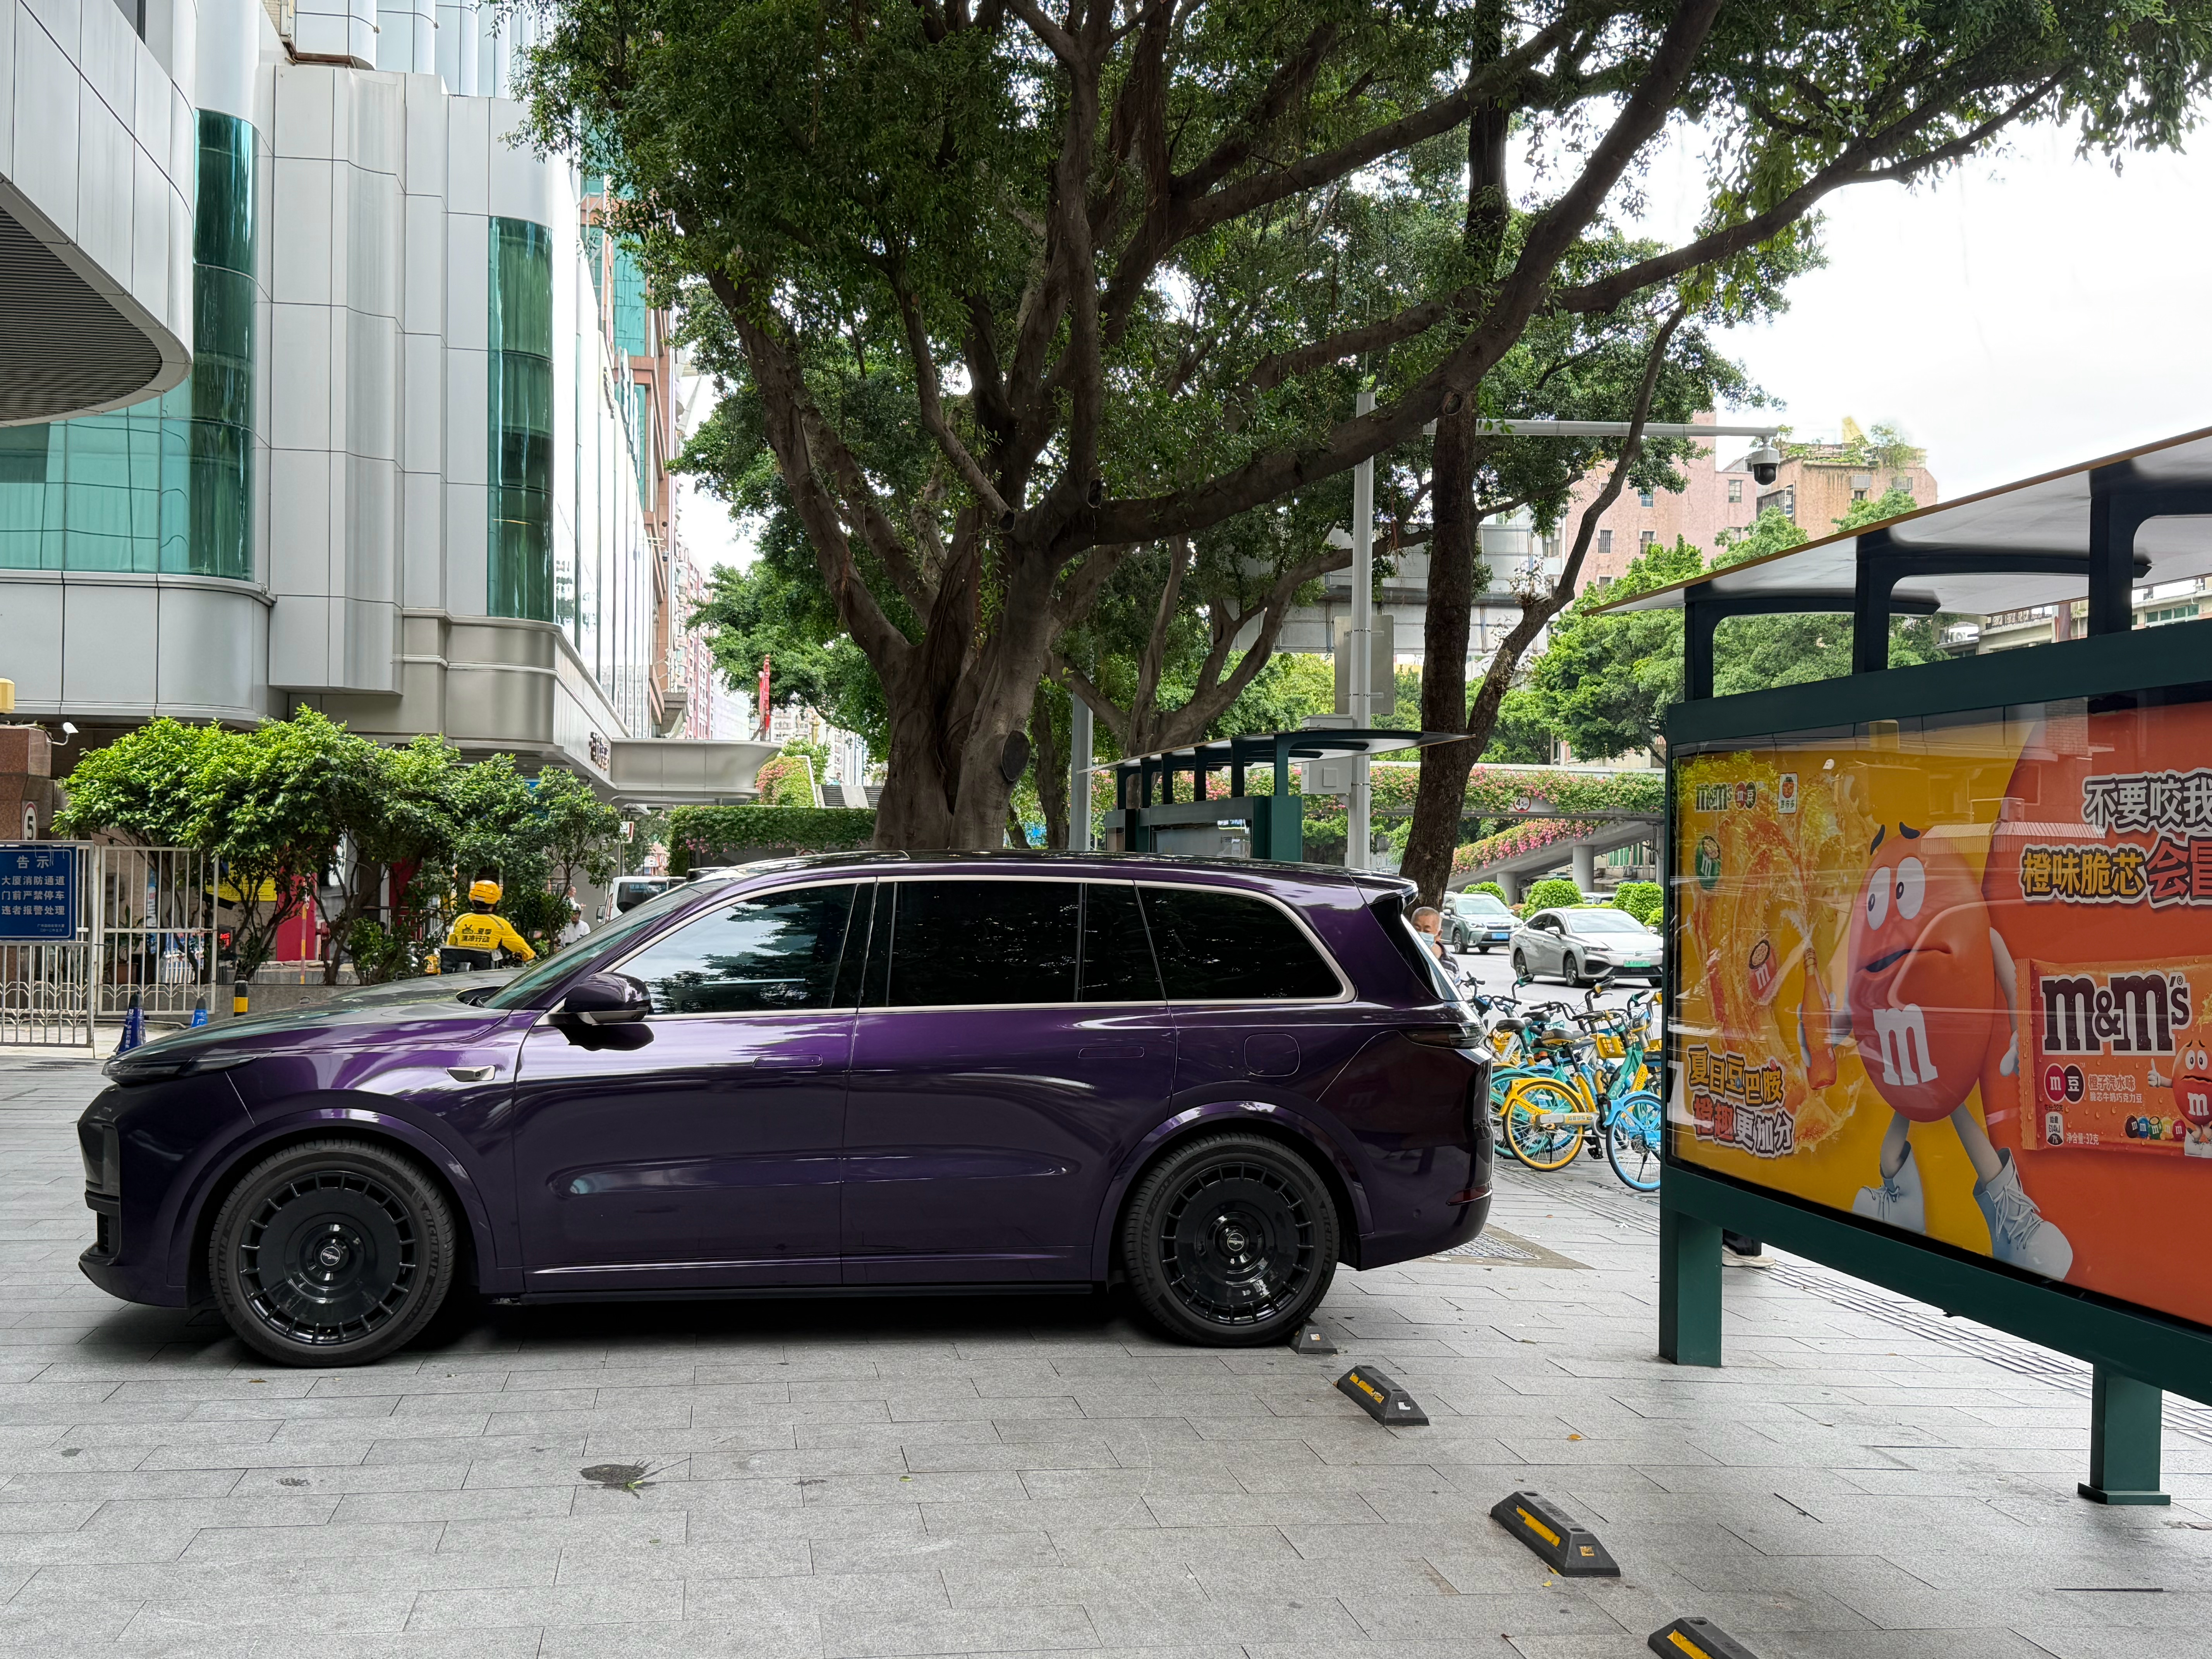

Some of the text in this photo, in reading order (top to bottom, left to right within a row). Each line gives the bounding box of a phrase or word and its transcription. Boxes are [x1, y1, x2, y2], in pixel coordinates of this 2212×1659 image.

[27, 816, 34, 840] 5
[17, 855, 49, 869] 告示
[2, 876, 65, 886] 大厦消防通道
[2, 890, 65, 900] 门前严禁停车
[2, 905, 65, 915] 违者报警处理
[1873, 1003, 1938, 1085] m
[2088, 1074, 2135, 1092] 橙子汽水味
[422, 1209, 439, 1277] MICHELIN
